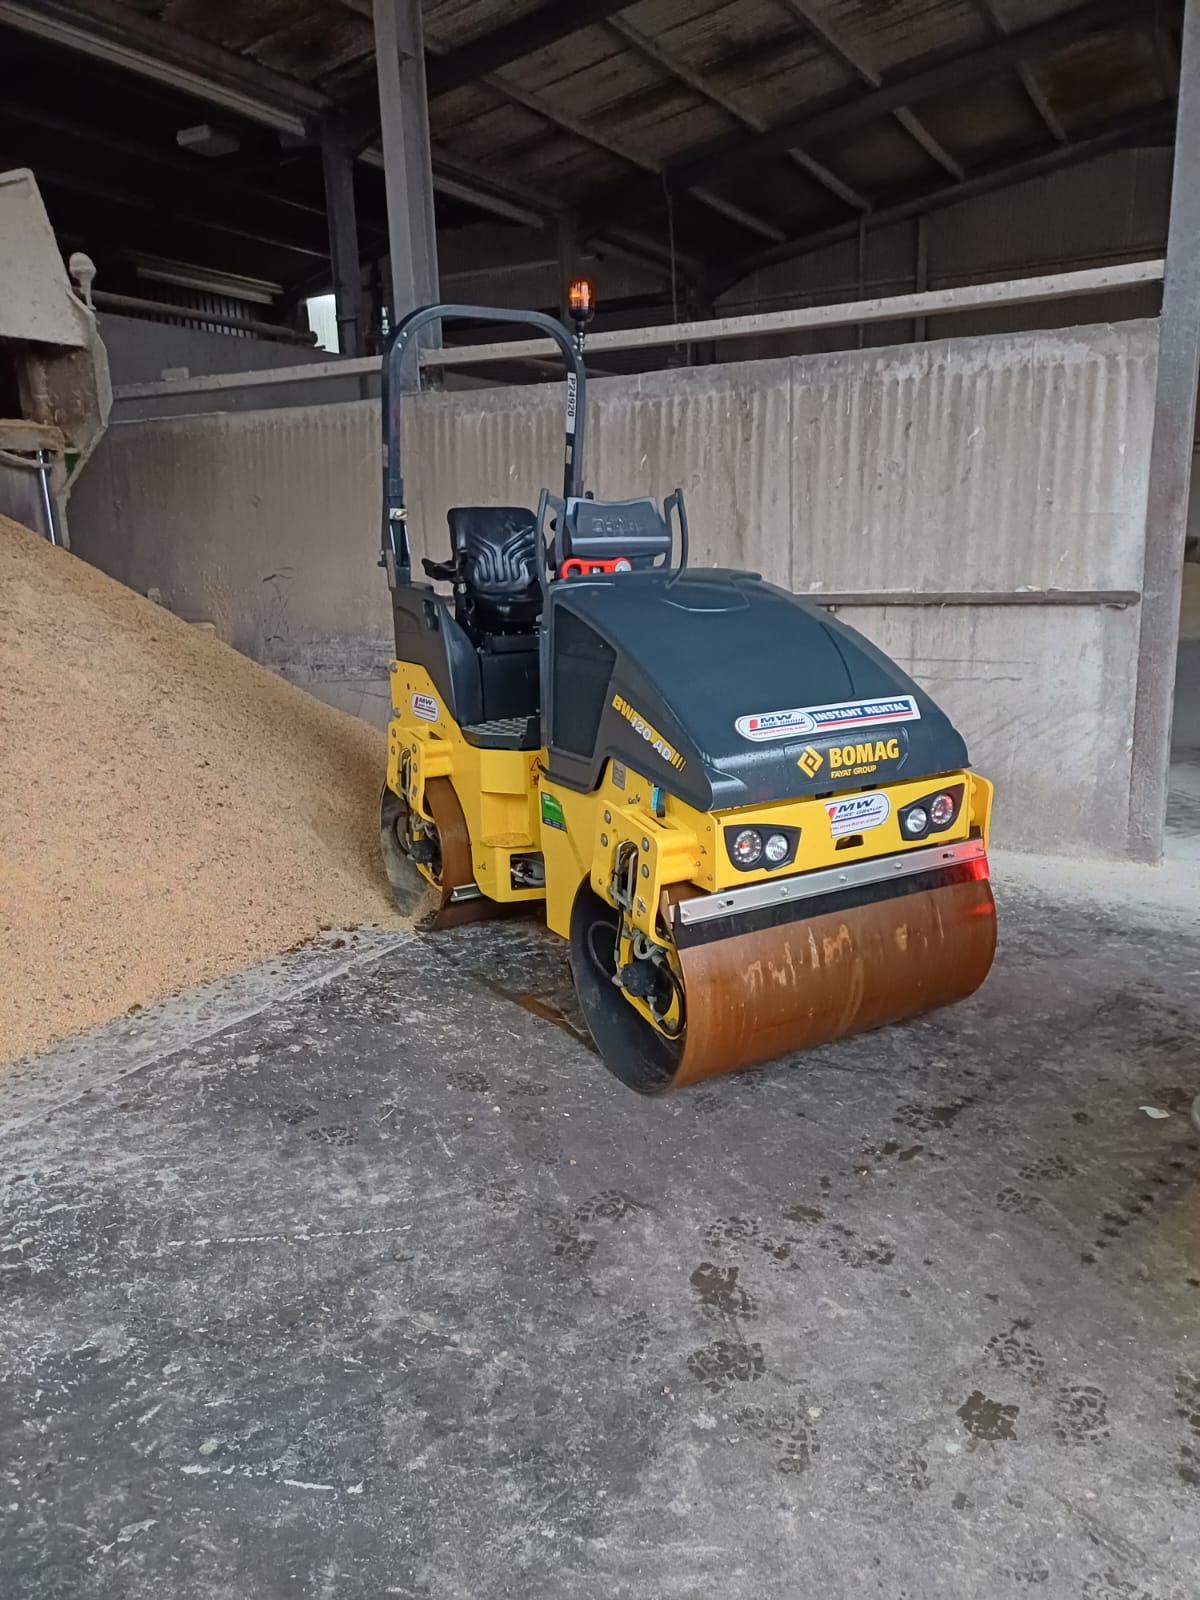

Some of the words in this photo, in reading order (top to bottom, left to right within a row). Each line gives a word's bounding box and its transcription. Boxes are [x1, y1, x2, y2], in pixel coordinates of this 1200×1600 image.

[568, 377, 576, 417] P24920
[760, 714, 792, 724] MW
[813, 707, 863, 721] INSTANT
[863, 702, 909, 715] RENTAL
[653, 739, 672, 761] AD
[829, 738, 900, 769] BOMAG
[830, 768, 852, 779] FAYAT
[853, 764, 877, 775] GROUP
[838, 798, 875, 814] MW
